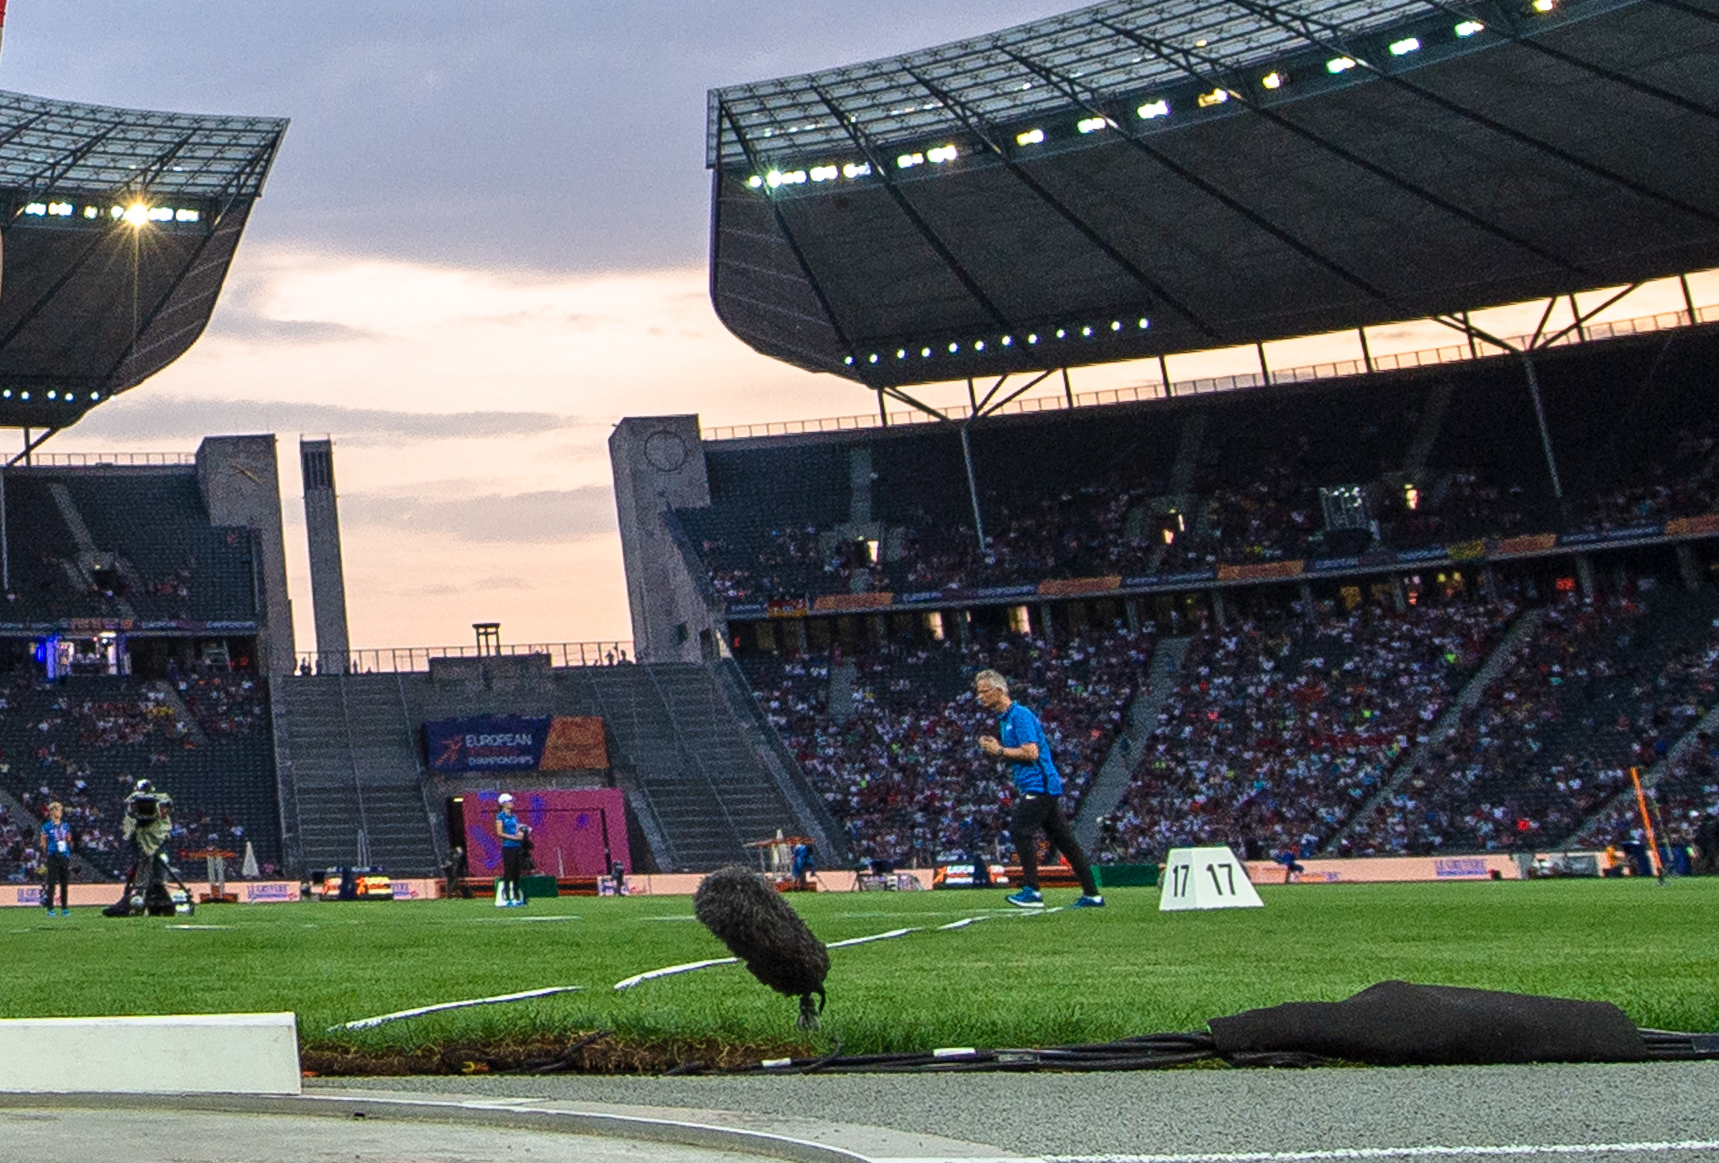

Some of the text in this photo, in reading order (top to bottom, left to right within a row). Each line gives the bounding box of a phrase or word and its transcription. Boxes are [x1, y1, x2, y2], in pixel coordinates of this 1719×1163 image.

[465, 733, 532, 747] EUROPEAN
[1172, 864, 1190, 897] 17
[1206, 863, 1235, 896] 17
